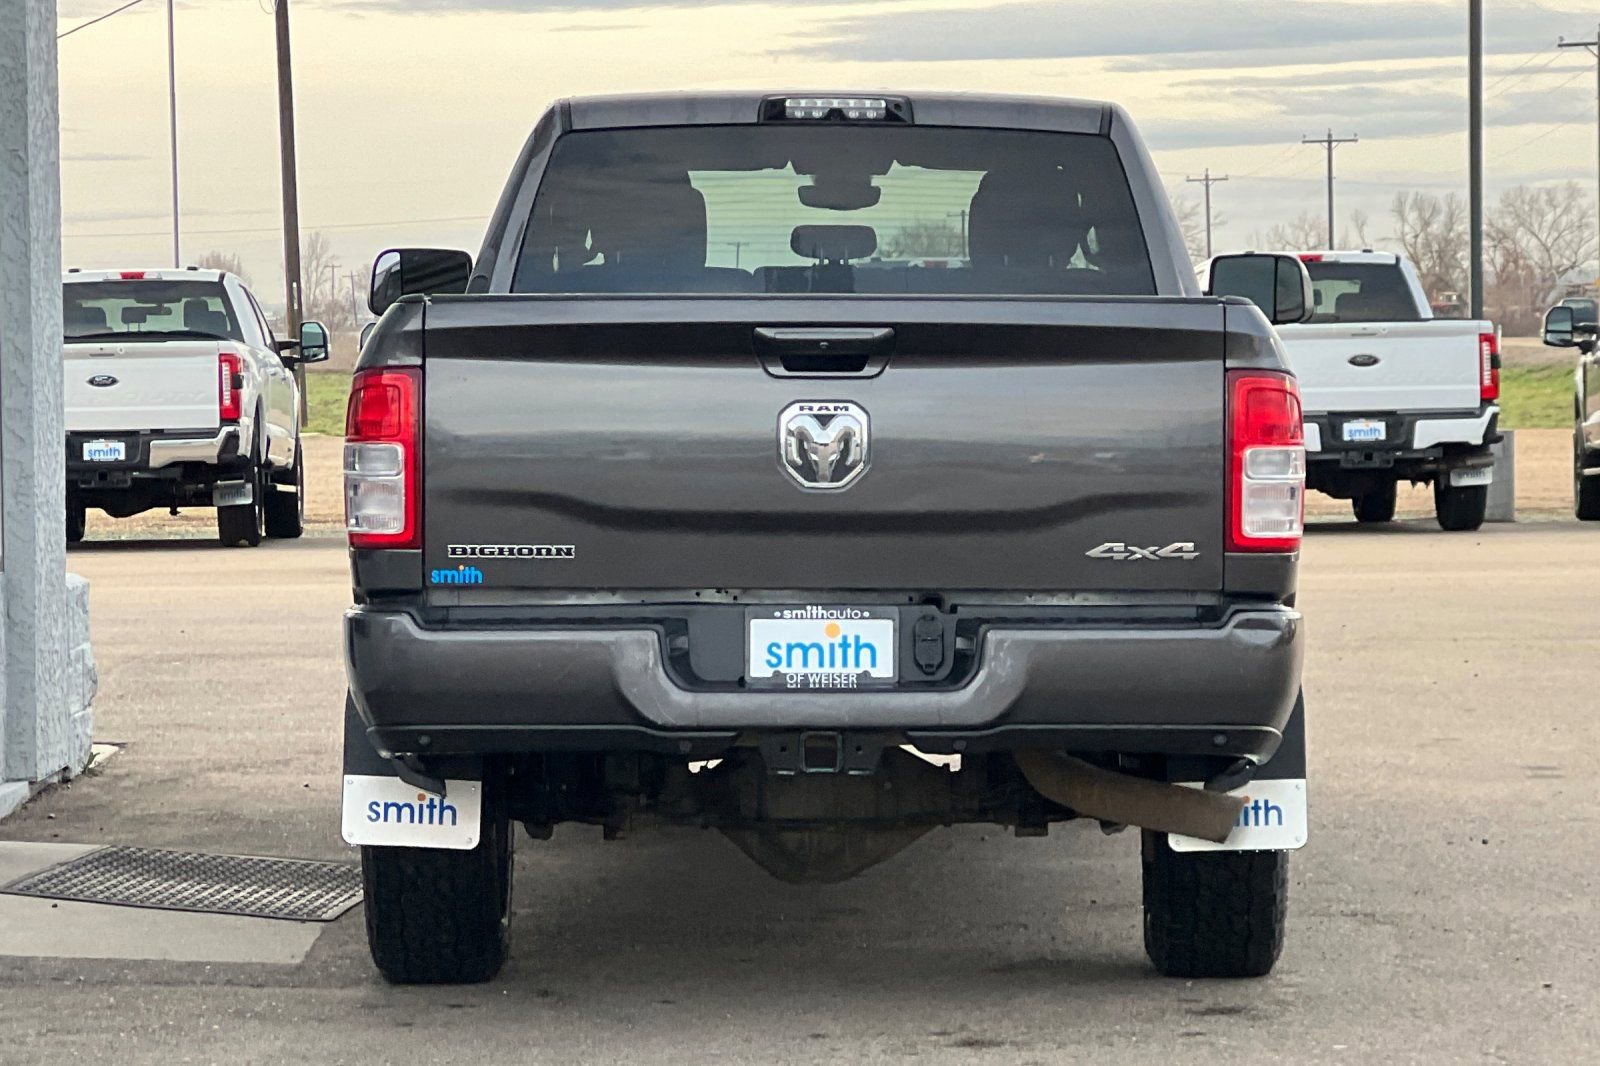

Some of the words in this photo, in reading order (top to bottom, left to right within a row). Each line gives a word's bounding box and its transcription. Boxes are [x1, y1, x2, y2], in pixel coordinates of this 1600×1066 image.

[1348, 423, 1381, 438] smith
[88, 442, 120, 457] smith
[448, 544, 575, 558] BIGHORN
[1085, 542, 1200, 560] 4x4
[431, 564, 483, 584] smith
[766, 622, 876, 668] smith
[786, 673, 805, 684] OF
[808, 673, 857, 684] WEISER
[367, 793, 457, 826] smith
[1233, 795, 1282, 826] ith
